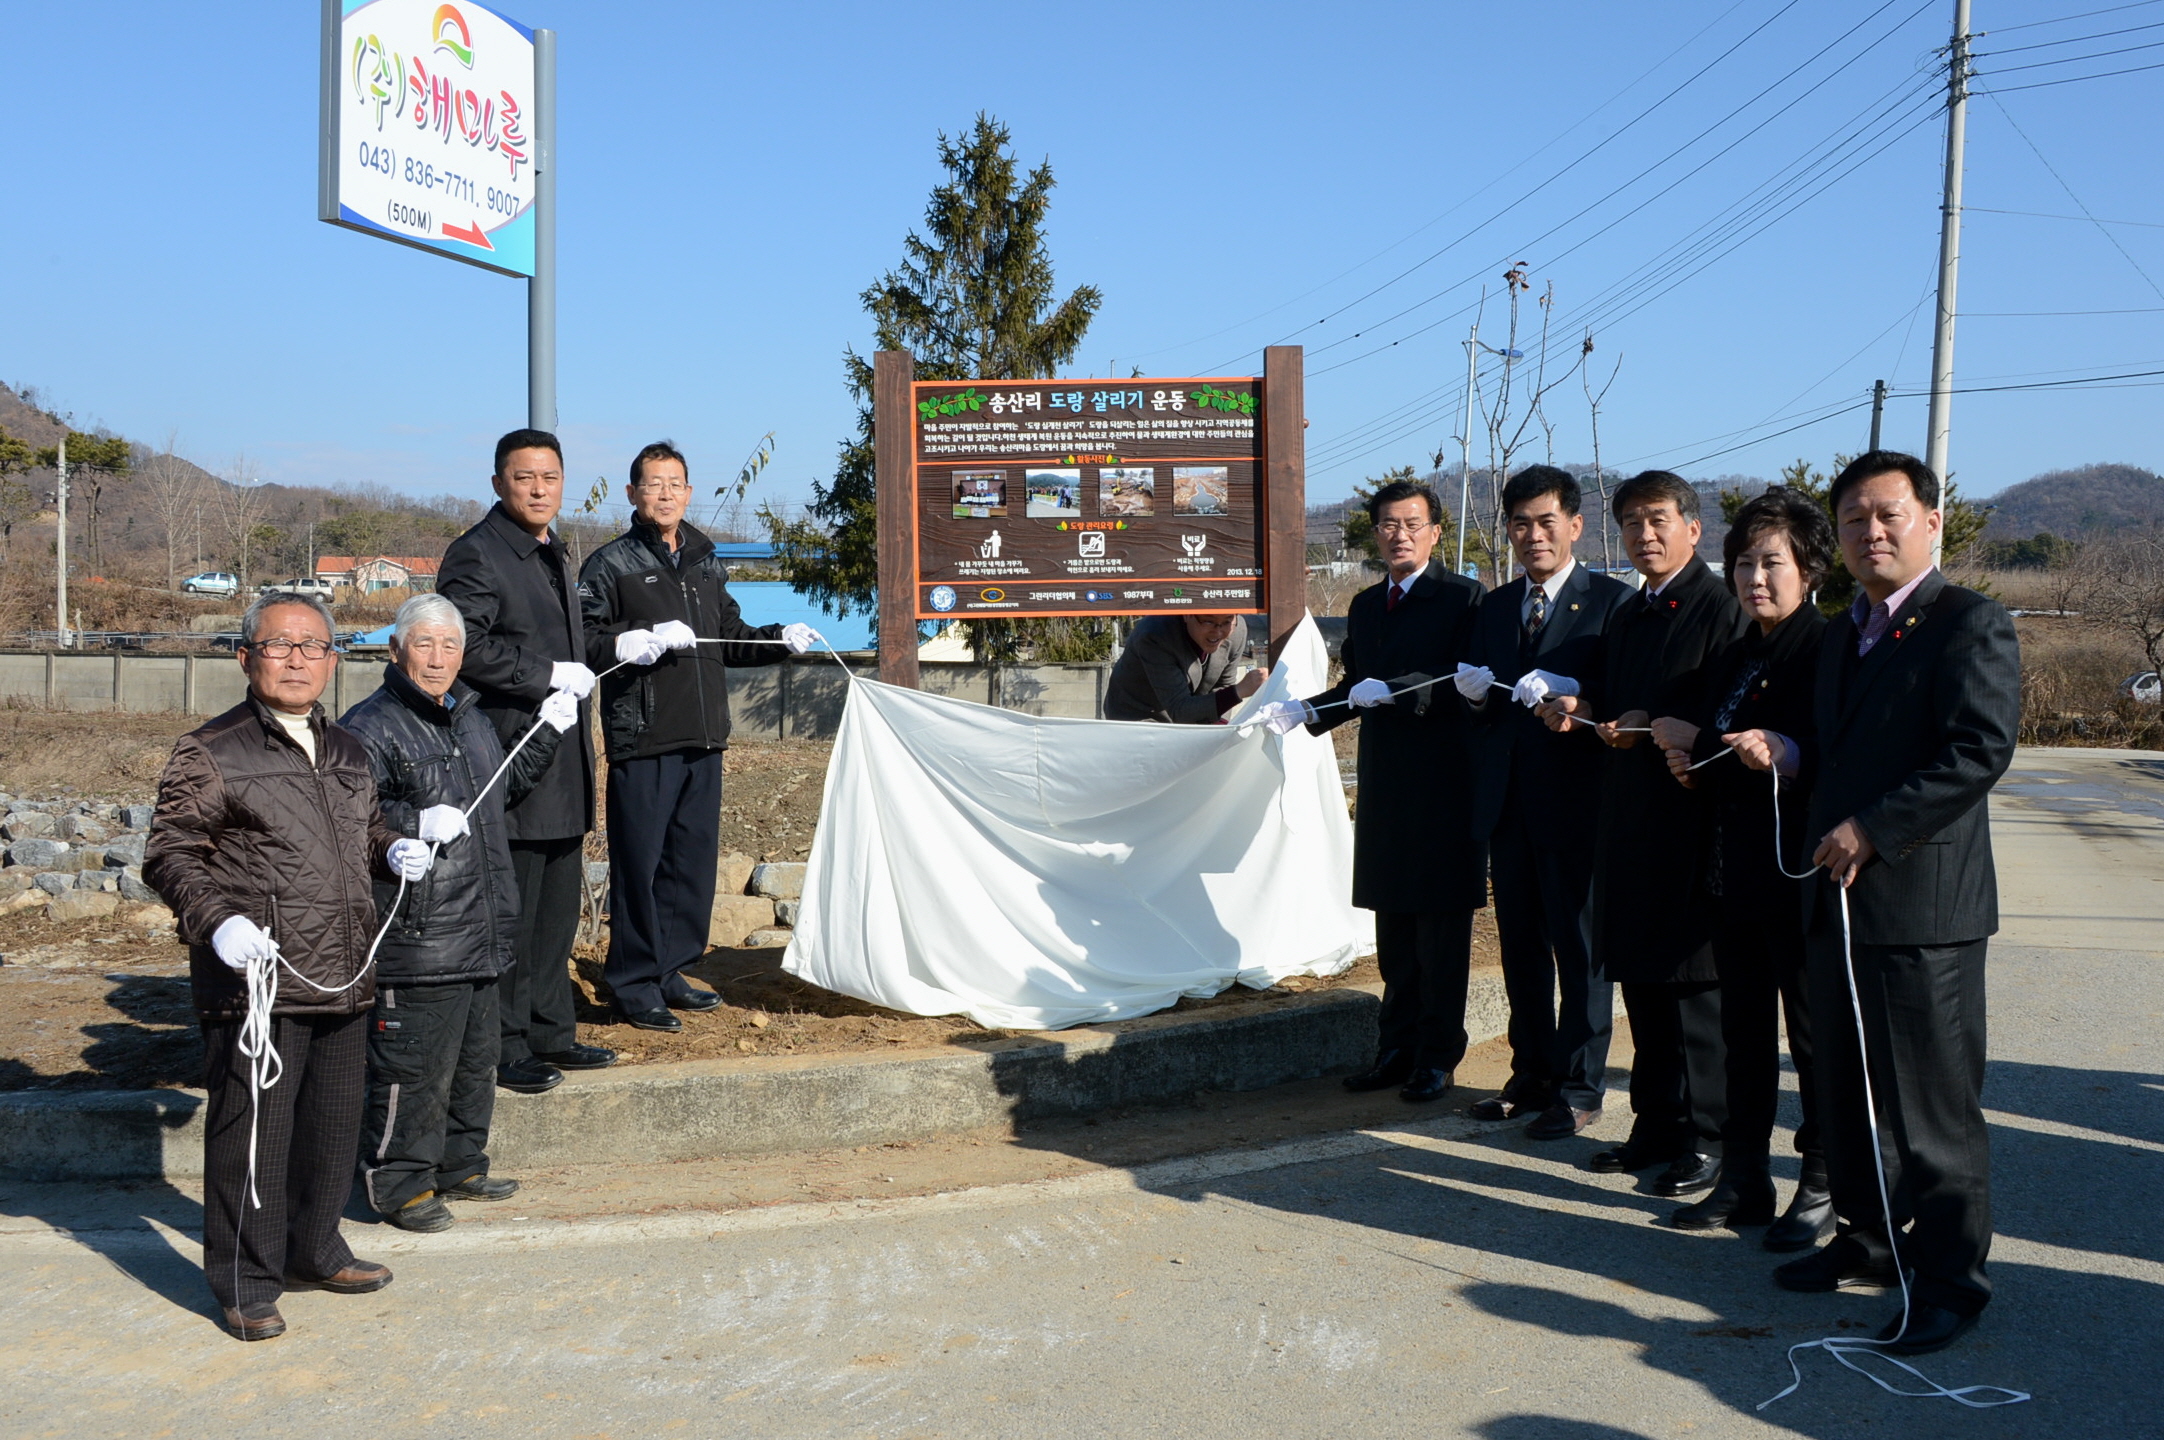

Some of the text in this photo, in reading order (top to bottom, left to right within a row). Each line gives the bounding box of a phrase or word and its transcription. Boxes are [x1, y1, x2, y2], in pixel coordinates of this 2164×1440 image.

[359, 141, 396, 179] 043)
[487, 187, 520, 218] 9007
[388, 199, 432, 233] (500M)
[988, 390, 1187, 414] 송산리 도랑 살리기 운동
[1089, 421, 1108, 430] 도랑을
[1195, 420, 1214, 428] 시키고
[1074, 432, 1107, 440] 지속적으로
[979, 444, 998, 452] 우리는
[1033, 444, 1058, 452] 도랑에서
[1070, 522, 1085, 530] 도랑
[1226, 568, 1263, 576] 2013. 12. 18
[1028, 591, 1076, 601] 그린리더협의체
[1098, 592, 1114, 600] SBS
[1122, 590, 1154, 599] 1987부대
[1202, 589, 1251, 599] 송산리 주민일동
